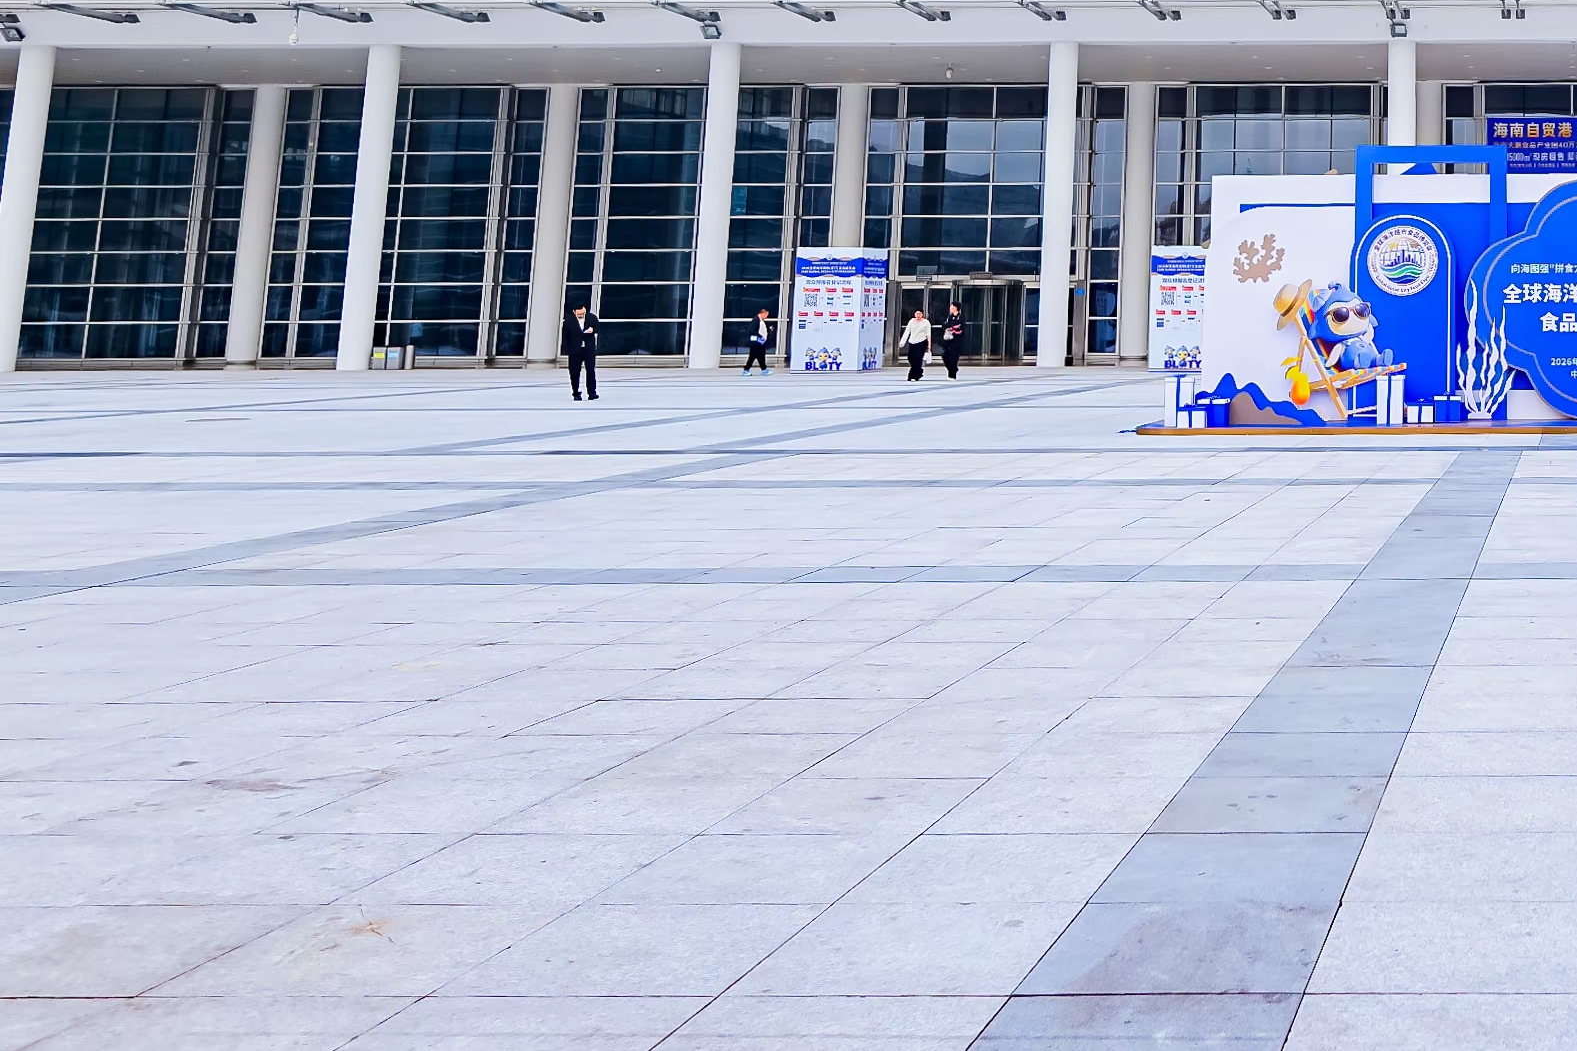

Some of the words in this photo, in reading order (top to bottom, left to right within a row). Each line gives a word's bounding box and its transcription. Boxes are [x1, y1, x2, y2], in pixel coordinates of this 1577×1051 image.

[1493, 122, 1572, 138] 海南自贸港
[805, 361, 842, 371] BLTY
[1164, 360, 1202, 369] BLTY
